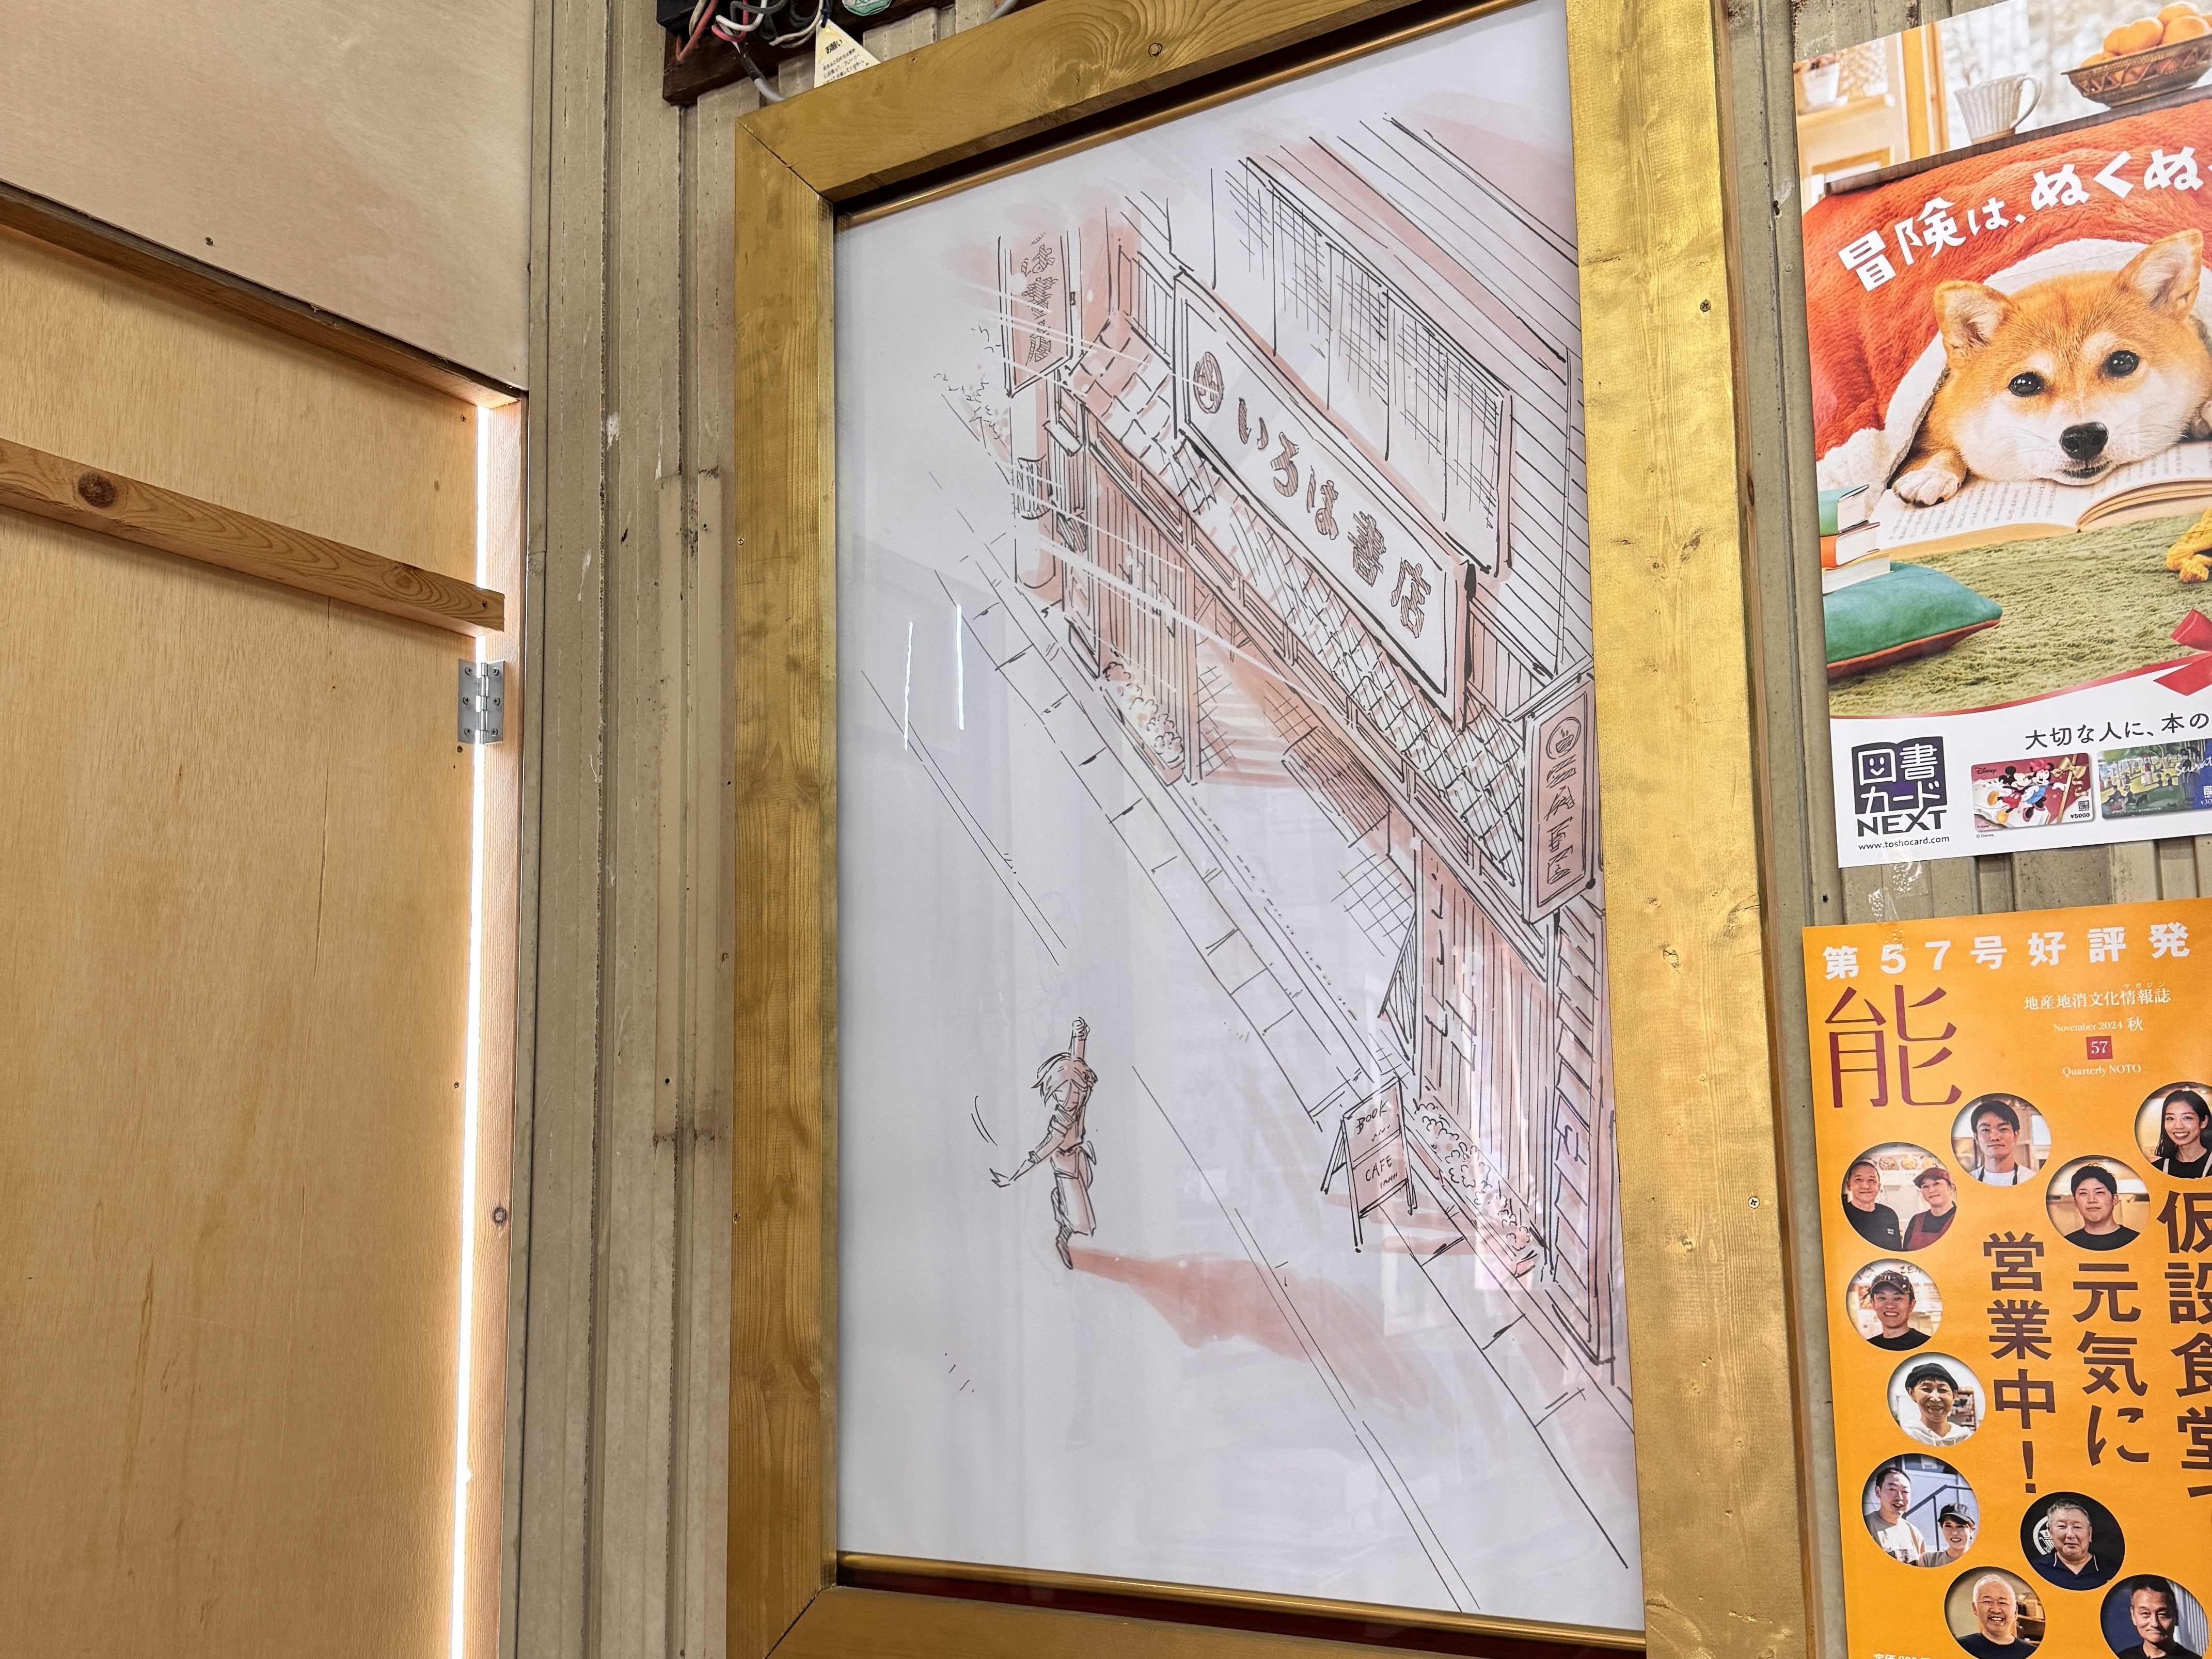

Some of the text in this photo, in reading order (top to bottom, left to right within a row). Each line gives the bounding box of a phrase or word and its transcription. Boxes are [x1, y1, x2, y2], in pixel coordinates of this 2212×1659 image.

[1838, 146, 2212, 292] 冒険は、ぬくぬ
[1238, 398, 1431, 638] いろは書店
[2025, 712, 2209, 750] 大切な人に、本の
[1857, 809, 1947, 837] NEXT
[1858, 836, 1950, 850] www.toshocard.com
[1822, 921, 2190, 979] 第57号好評発
[2024, 987, 2172, 1010] 地産地消文化情報誌
[2053, 1016, 2144, 1033] November 2024 秋
[1824, 984, 1962, 1108] 能
[2091, 1041, 2108, 1054] 57
[2062, 1064, 2141, 1078] Quarterly NOTO
[1356, 1100, 1389, 1135] BOOK
[1365, 1155, 1393, 1181] CAFE
[2156, 1190, 2212, 1498] 仮設食堂
[1983, 1231, 2056, 1494] 営業中!
[2072, 1262, 2149, 1466] 元気に
